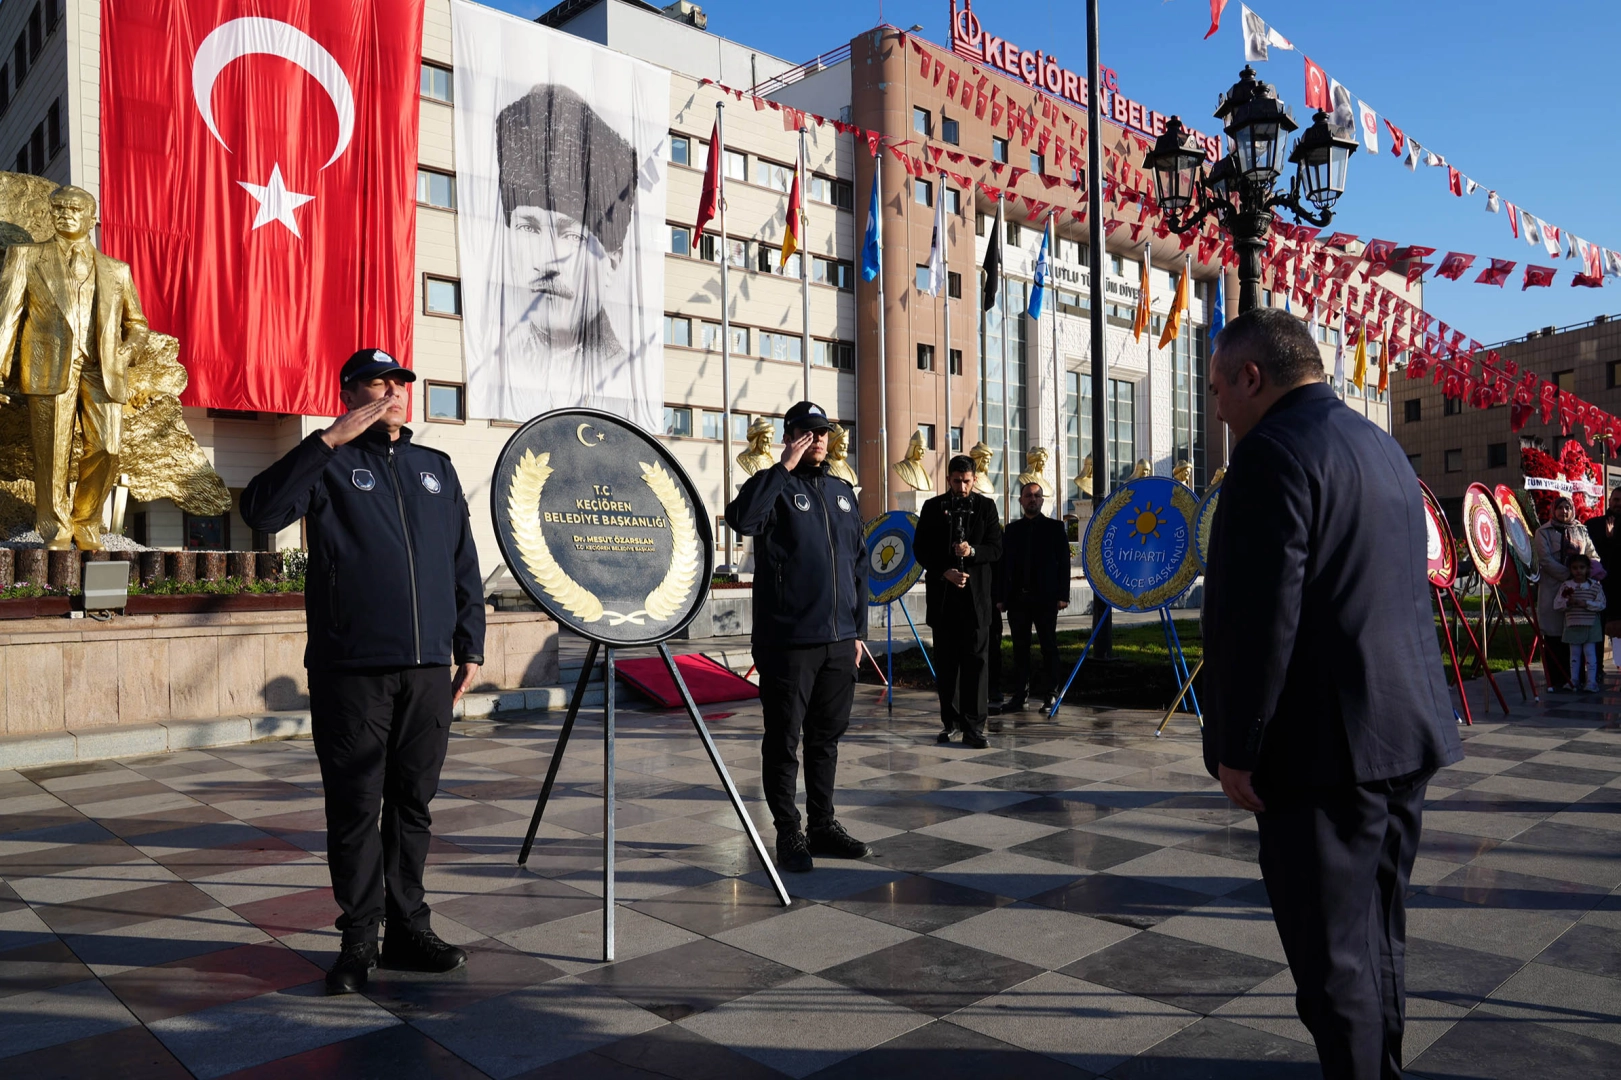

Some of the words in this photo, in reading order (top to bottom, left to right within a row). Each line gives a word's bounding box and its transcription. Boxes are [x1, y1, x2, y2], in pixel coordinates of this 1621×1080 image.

[593, 485, 613, 496] T.C.
[576, 498, 632, 512] KEÇİÖREN
[543, 511, 600, 525] BELEDİYE
[602, 514, 667, 528] BAŞKANLIĞI
[573, 535, 586, 543] Dr.
[587, 536, 613, 544] MESUT
[614, 535, 654, 545] ÖZARSLAN
[1103, 524, 1122, 579] KEÇİÖREN
[1121, 573, 1145, 590] İLÇE
[1147, 525, 1185, 587] BAŞKANLIĞI
[1118, 548, 1134, 561] İYİ
[1134, 550, 1166, 563] PARTİ
